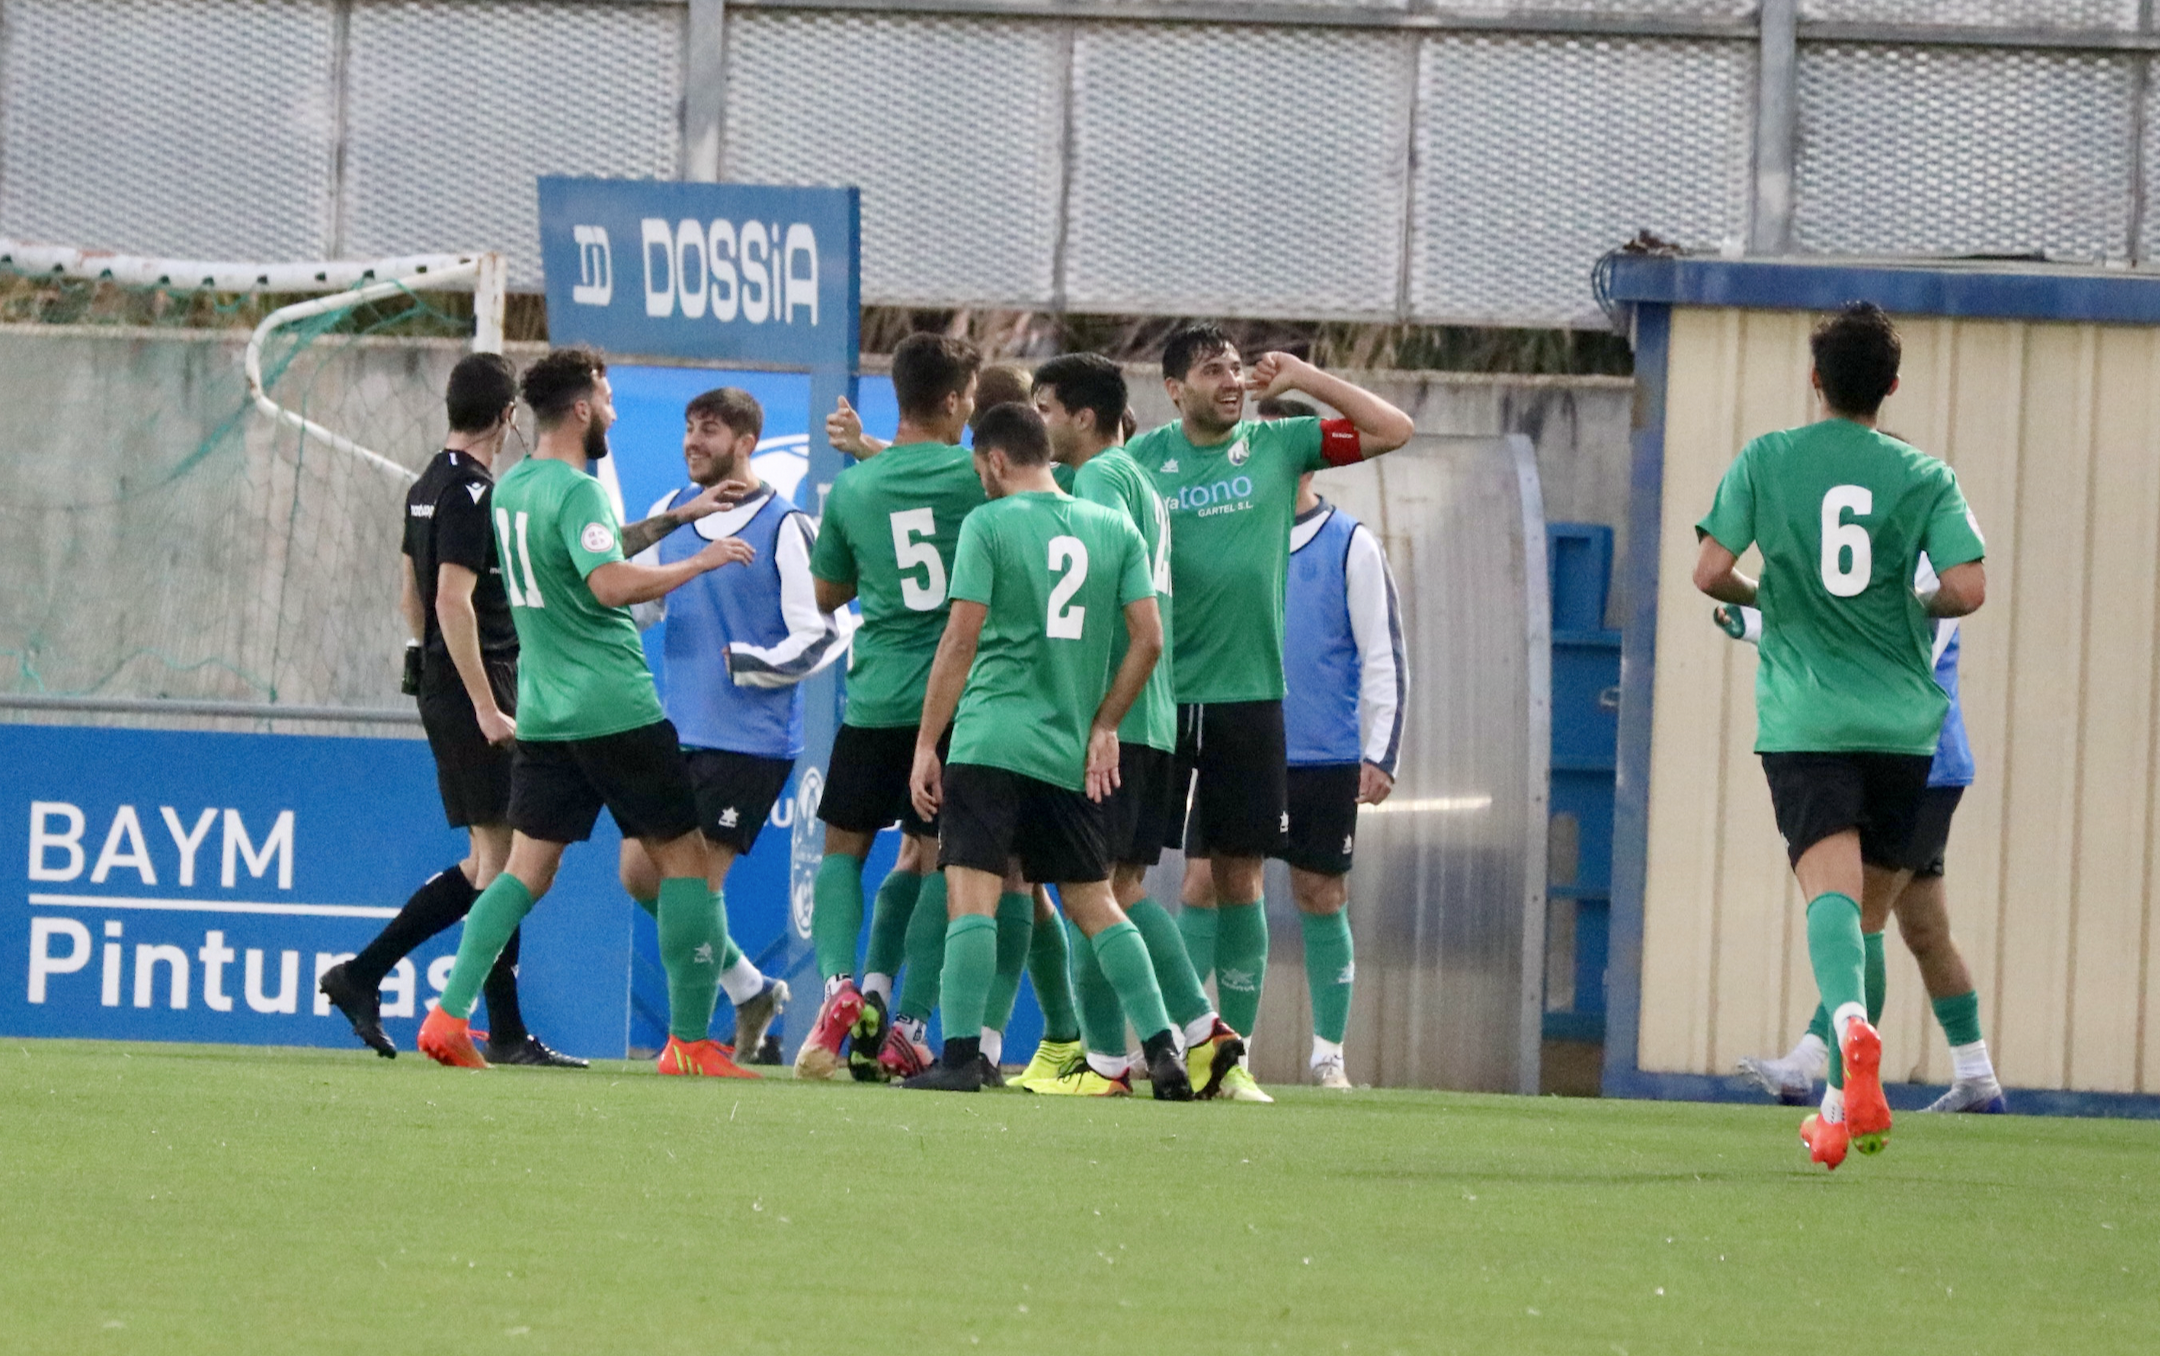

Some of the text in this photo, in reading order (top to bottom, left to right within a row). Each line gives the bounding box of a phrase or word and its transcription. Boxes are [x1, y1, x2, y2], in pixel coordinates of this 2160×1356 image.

[495, 507, 544, 608] 11
[889, 507, 946, 611] 5
[1197, 500, 1254, 518] GARTEL S.L.
[1821, 484, 1872, 597] 6
[1046, 534, 1089, 640] 2
[28, 800, 295, 890] BAYM
